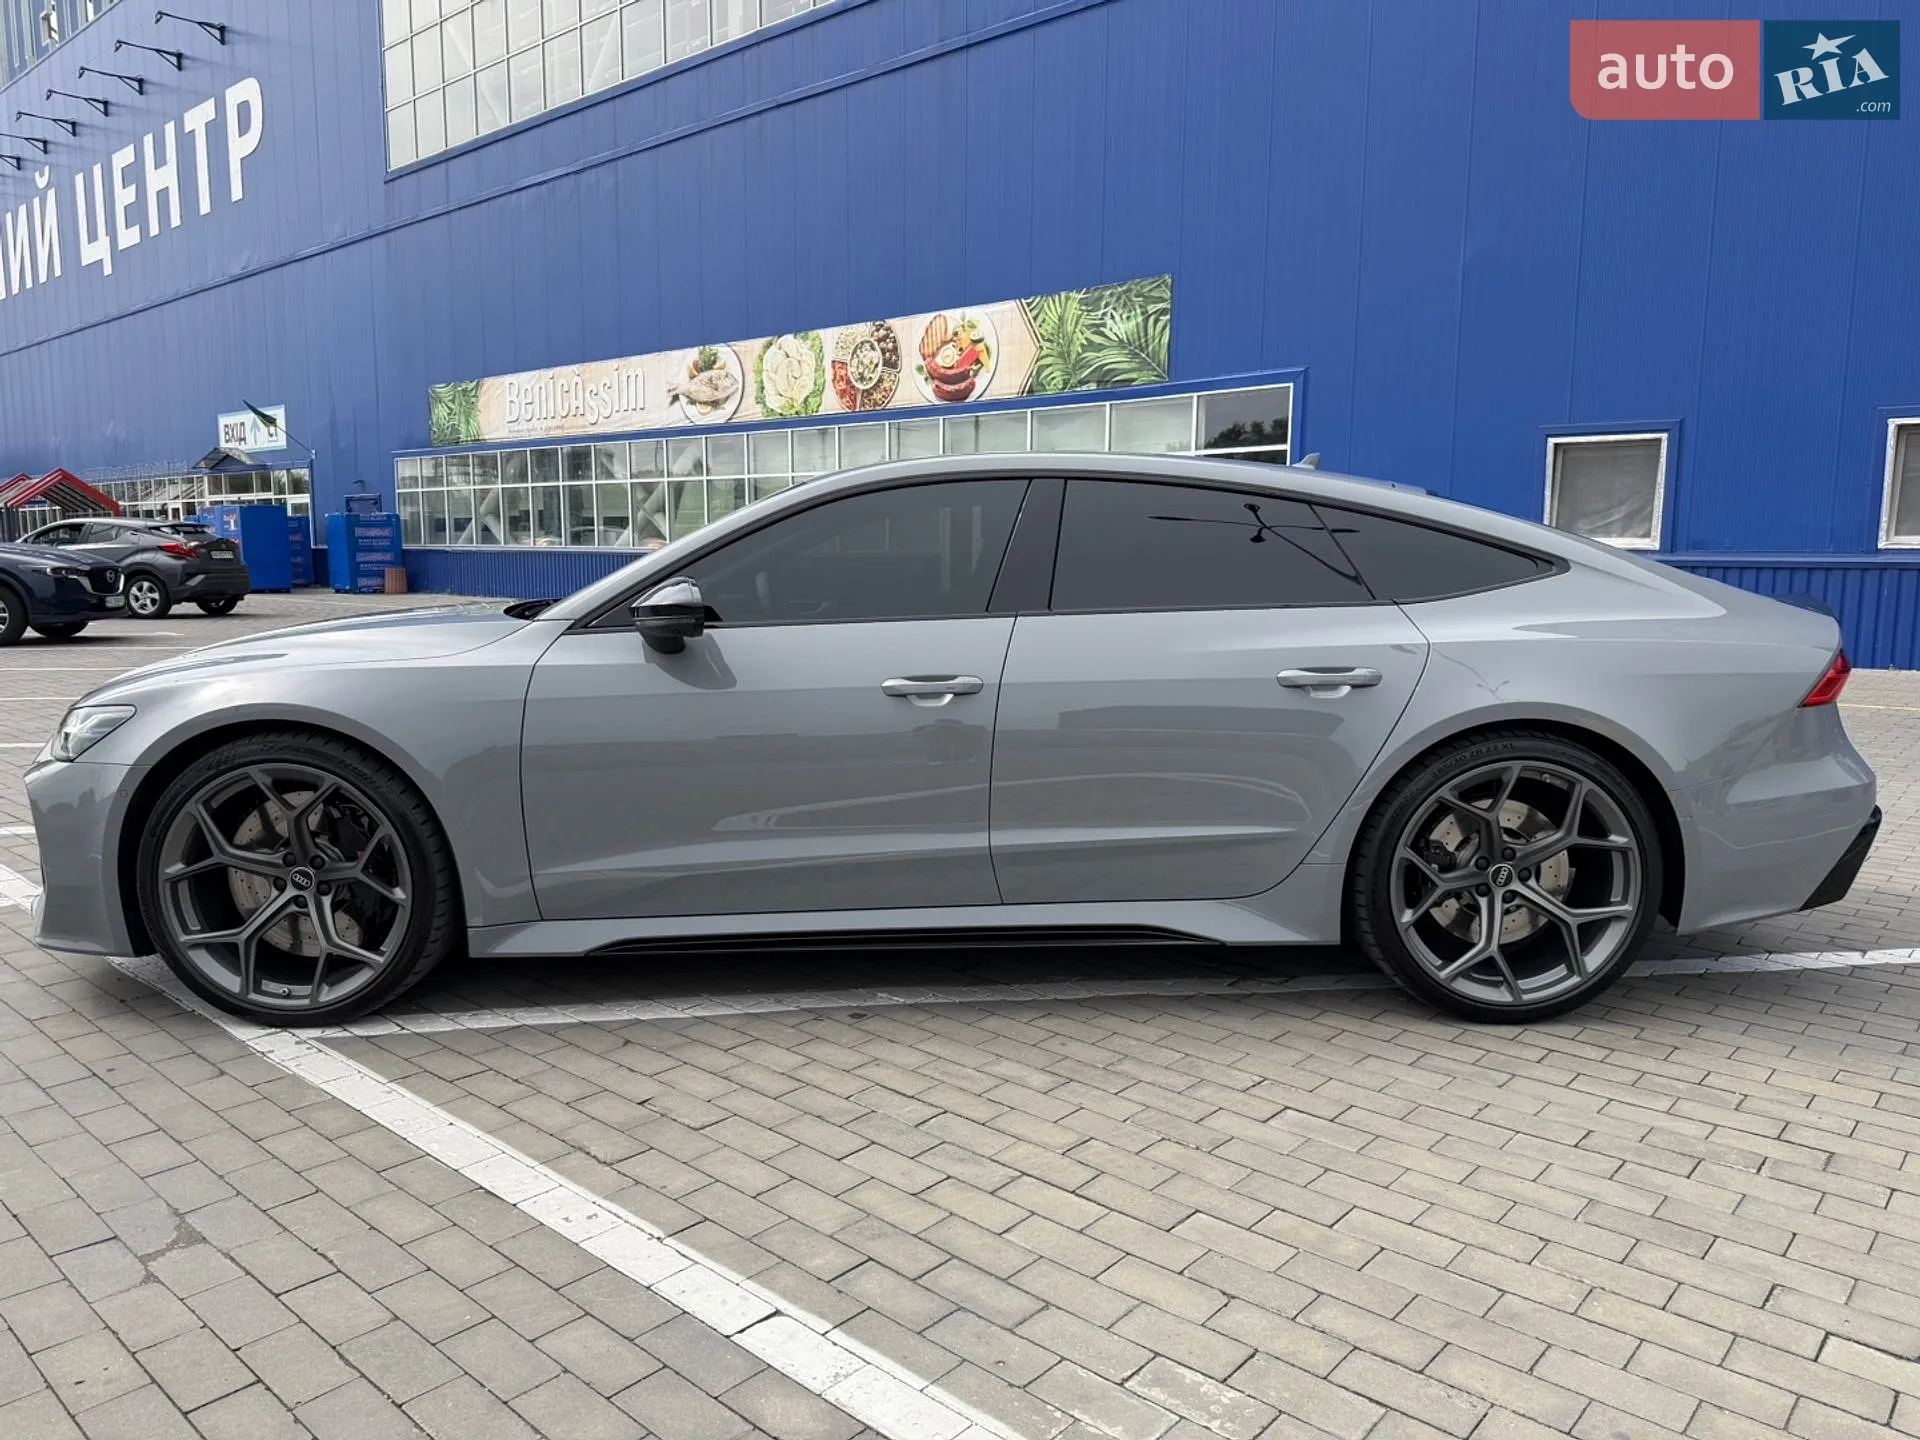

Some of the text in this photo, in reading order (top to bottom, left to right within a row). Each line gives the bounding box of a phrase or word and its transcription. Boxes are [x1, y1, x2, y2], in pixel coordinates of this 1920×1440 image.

[0, 76, 264, 300] ИЙ ЦЕНТР
[223, 421, 247, 445] ВХІД
